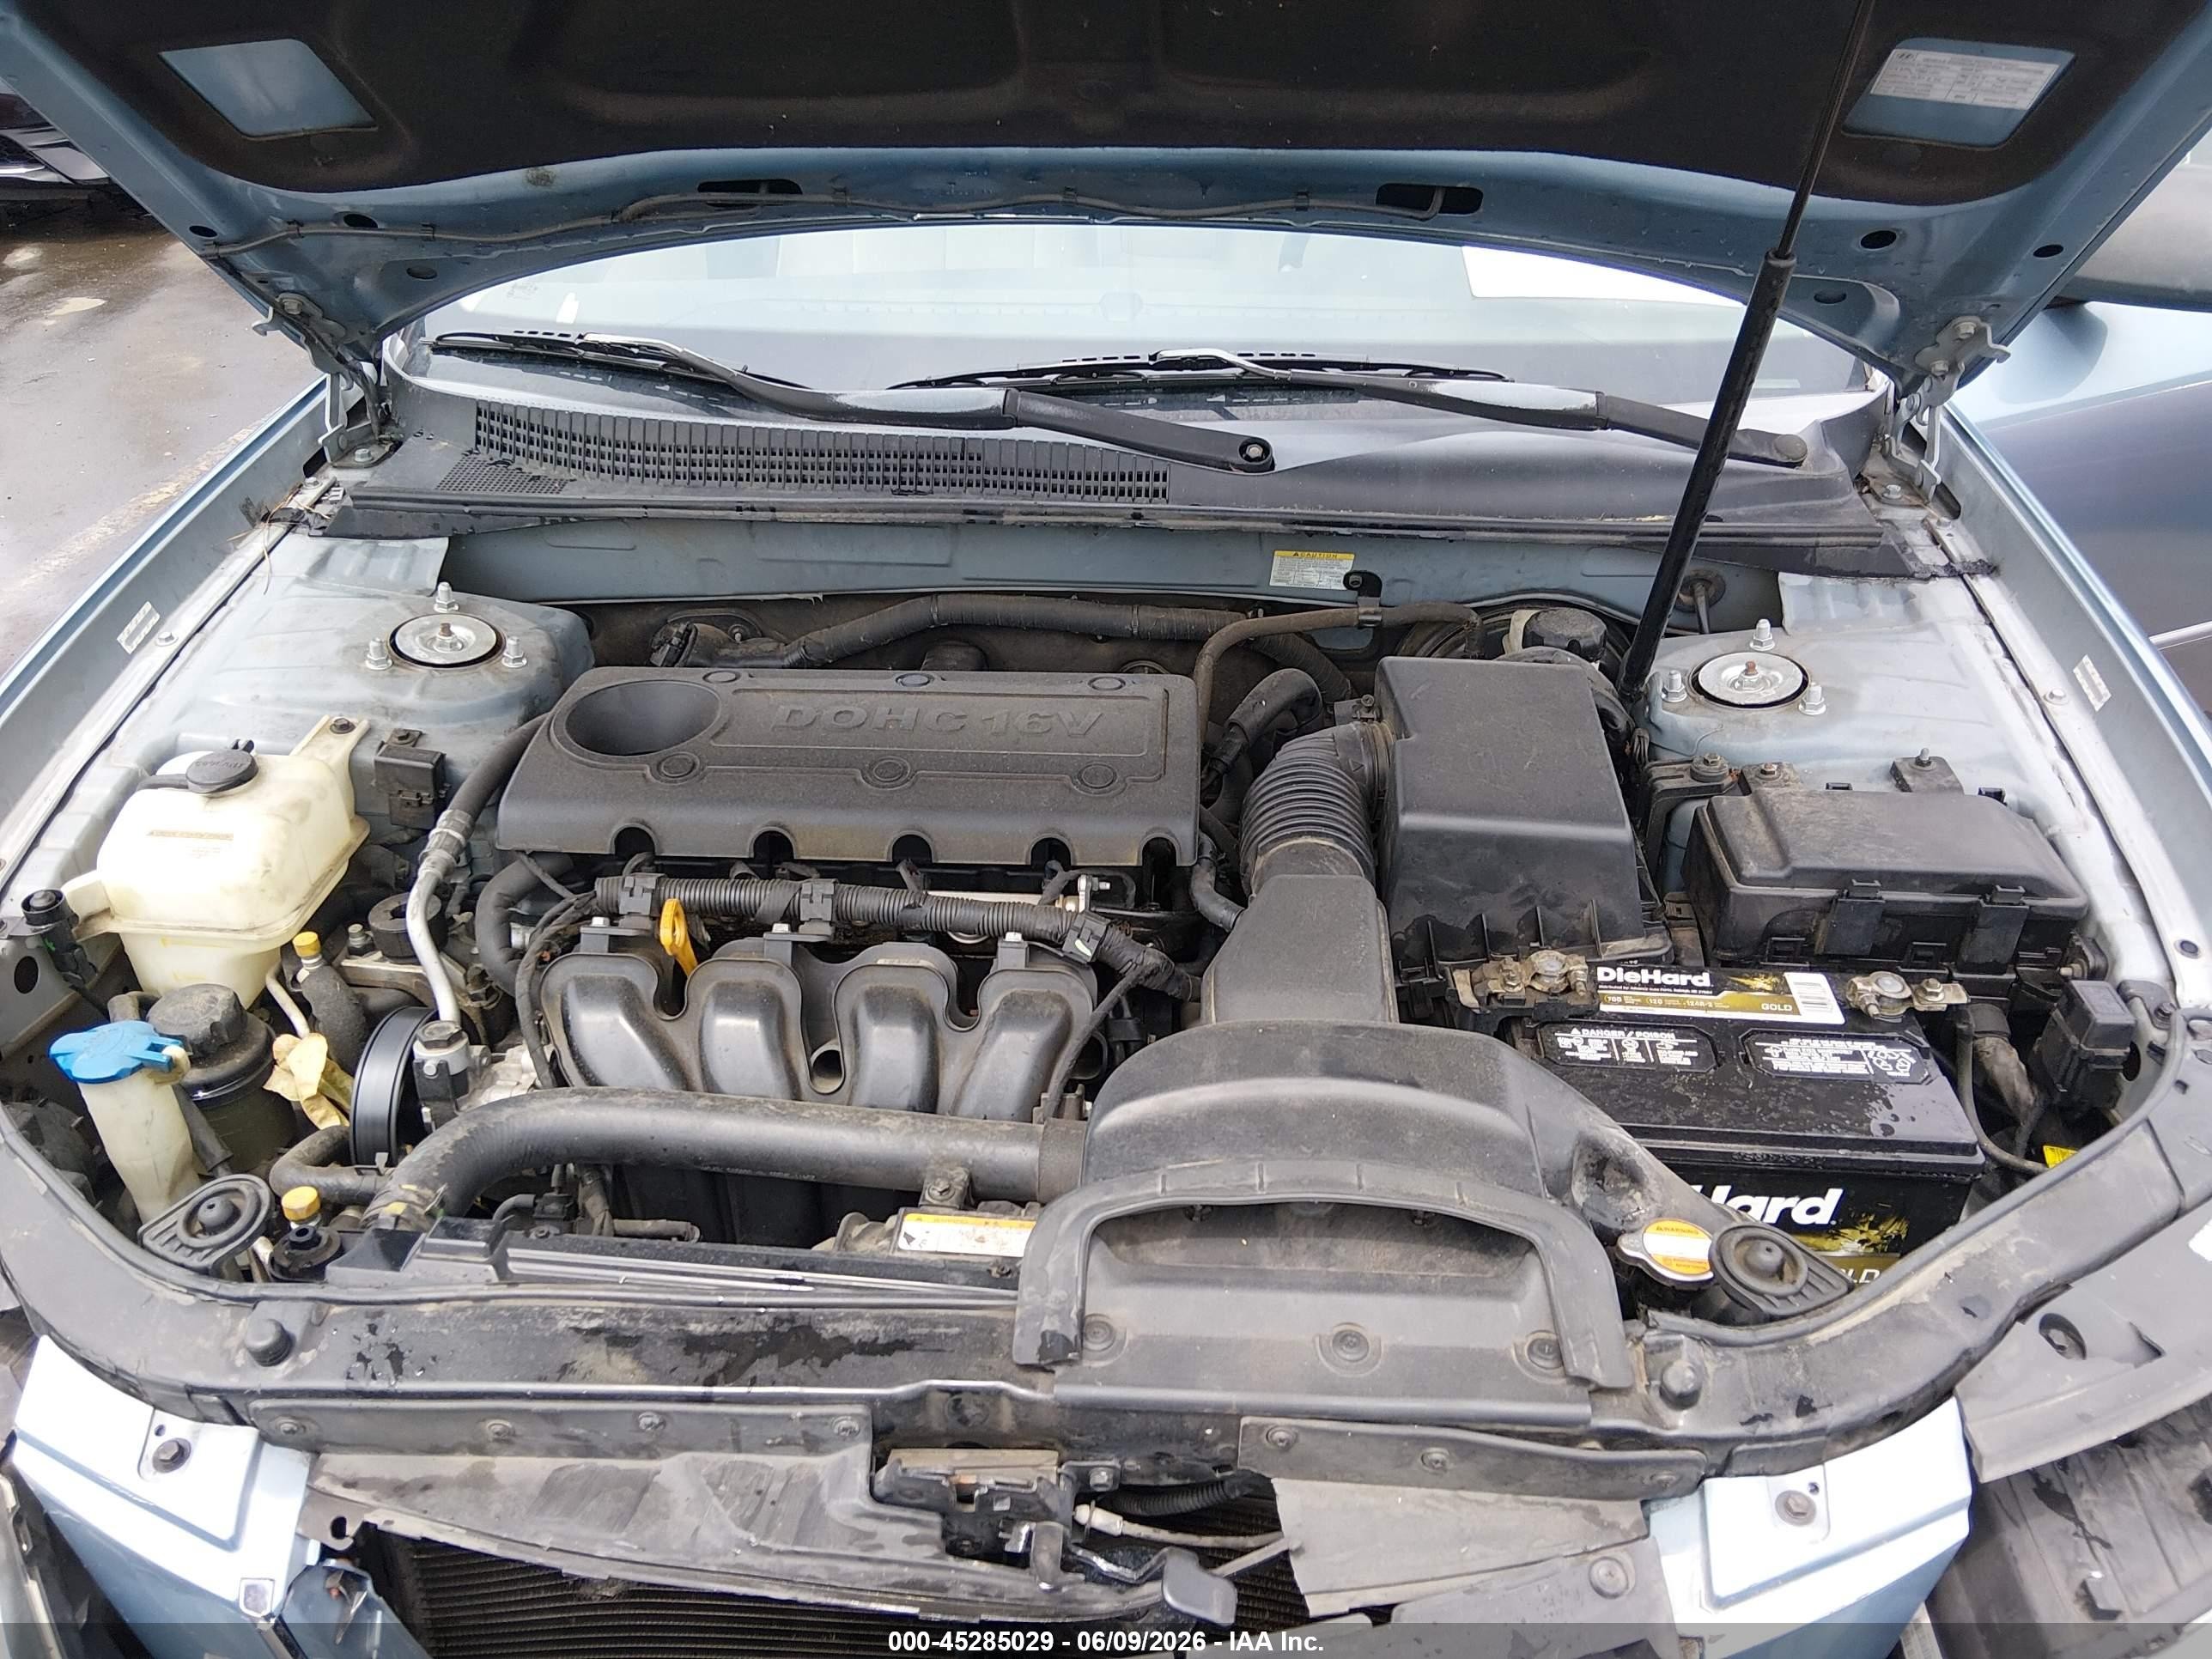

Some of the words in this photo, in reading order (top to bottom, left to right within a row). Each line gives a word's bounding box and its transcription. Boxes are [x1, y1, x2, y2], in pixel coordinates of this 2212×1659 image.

[772, 704, 969, 733] DOHC
[981, 708, 1104, 738] 16V
[1761, 1002, 1793, 1012] GOLD
[1581, 1028, 1626, 1038] DANGER
[1636, 1030, 1676, 1039] POISON
